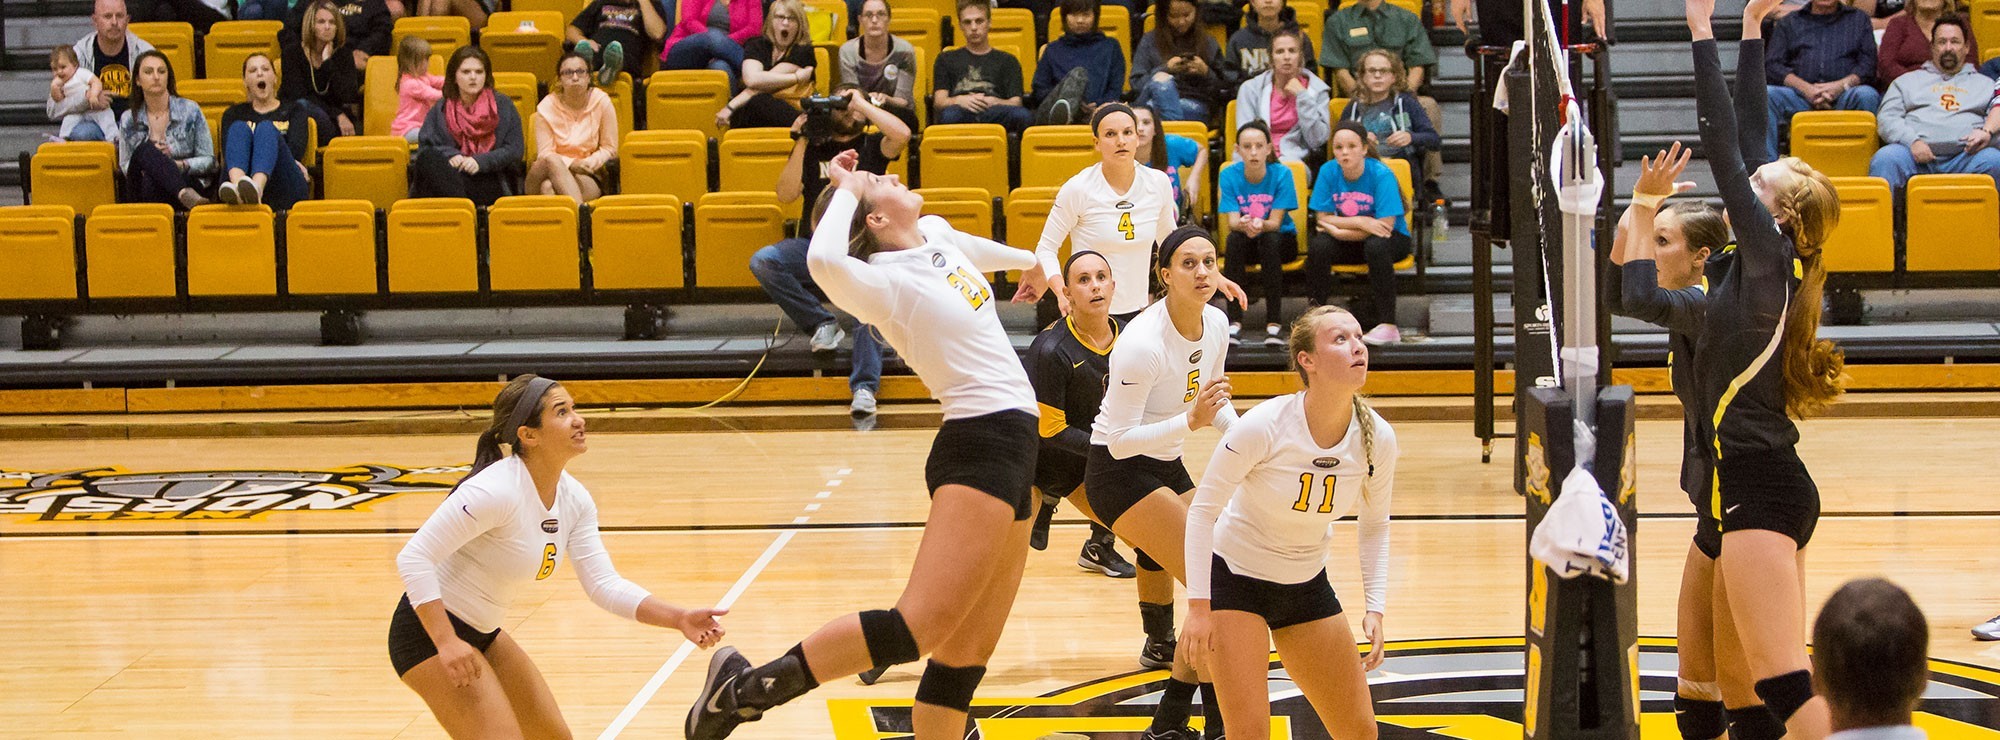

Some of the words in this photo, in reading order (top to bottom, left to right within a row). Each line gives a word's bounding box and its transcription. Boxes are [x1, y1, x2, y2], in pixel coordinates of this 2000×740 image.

[1118, 212, 1135, 241] 4
[947, 266, 990, 311] 21
[1184, 368, 1200, 403] 5
[1291, 472, 1337, 513] 11
[535, 542, 557, 581] 6
